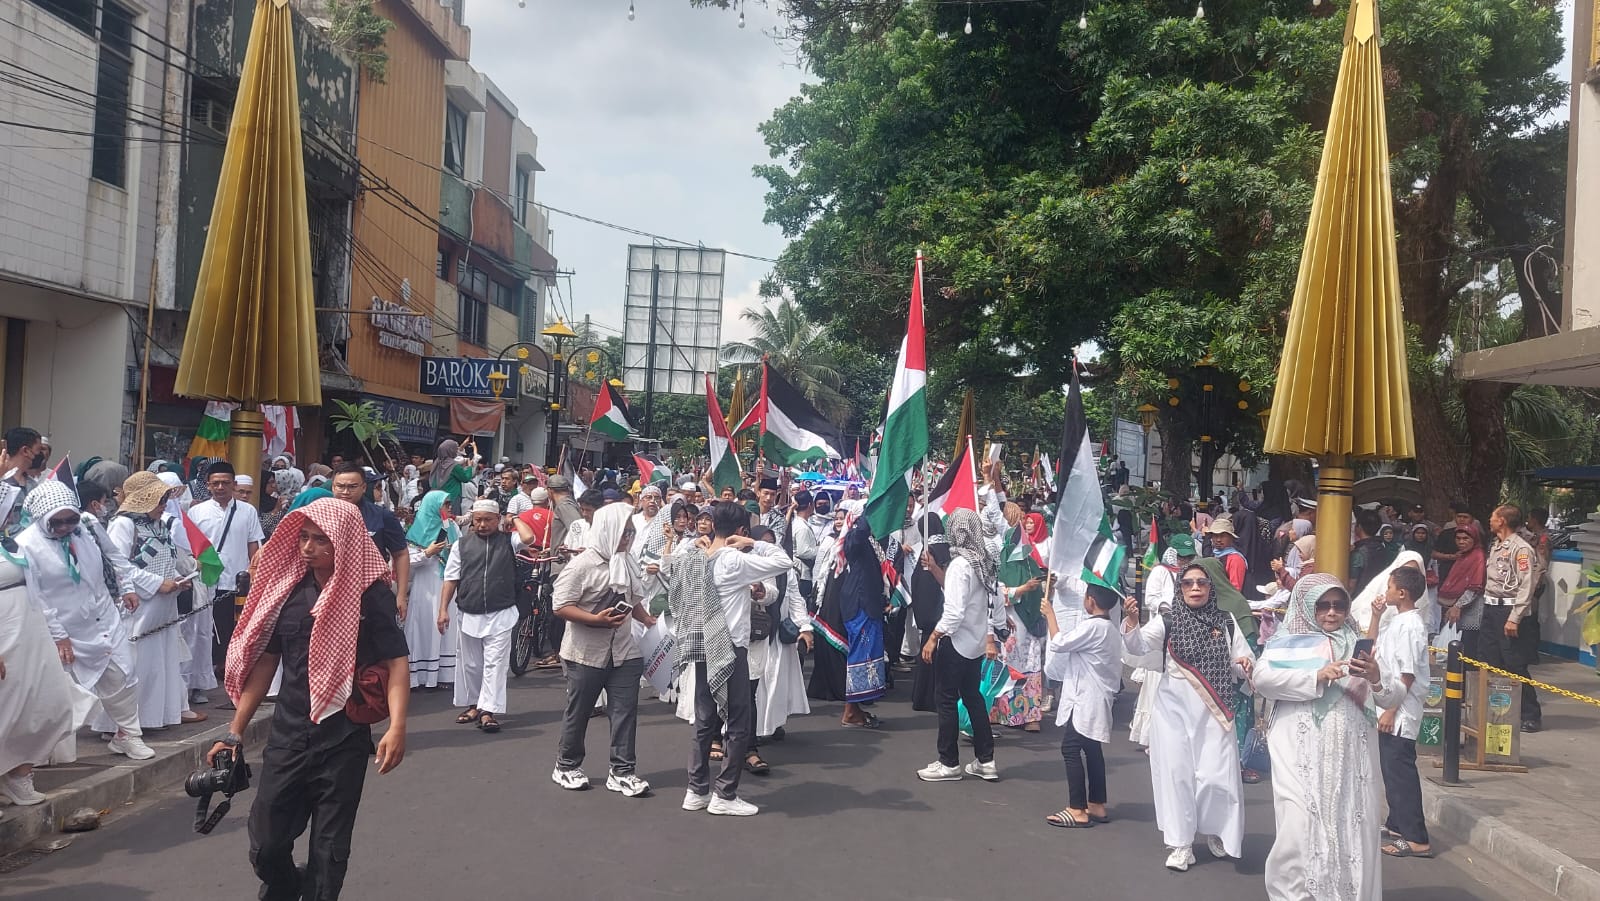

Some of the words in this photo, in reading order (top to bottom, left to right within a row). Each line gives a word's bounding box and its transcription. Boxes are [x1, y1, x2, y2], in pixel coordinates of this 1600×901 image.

[397, 406, 440, 429] BAROKAH
[663, 639, 675, 653] FREE
[646, 650, 666, 678] PALESTINE
